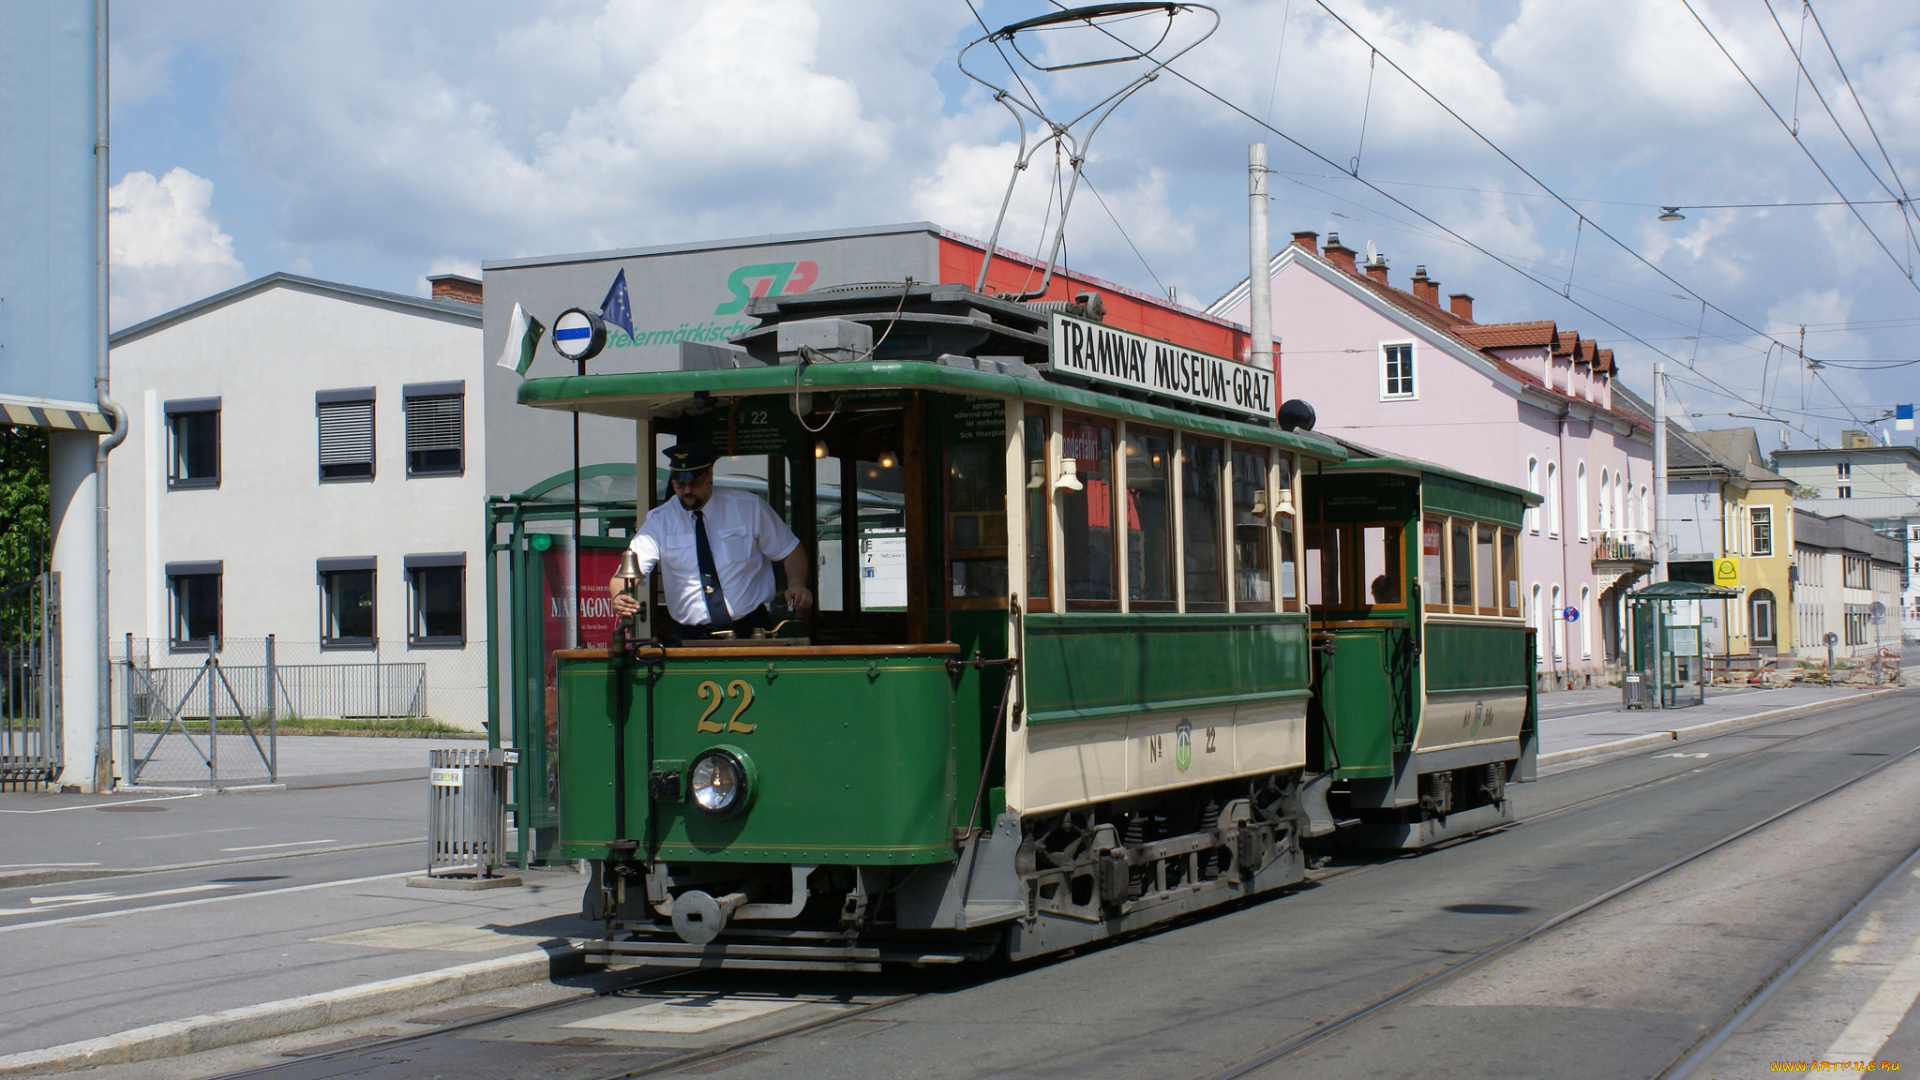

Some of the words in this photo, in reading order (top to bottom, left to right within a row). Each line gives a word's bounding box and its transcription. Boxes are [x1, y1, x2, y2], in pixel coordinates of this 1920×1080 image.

[1061, 319, 1148, 383] TRAMWAY
[1153, 345, 1270, 413] MUSEUM-GRAZ
[751, 411, 768, 424] 22
[697, 679, 757, 734] 22
[1206, 726, 1216, 754] 22
